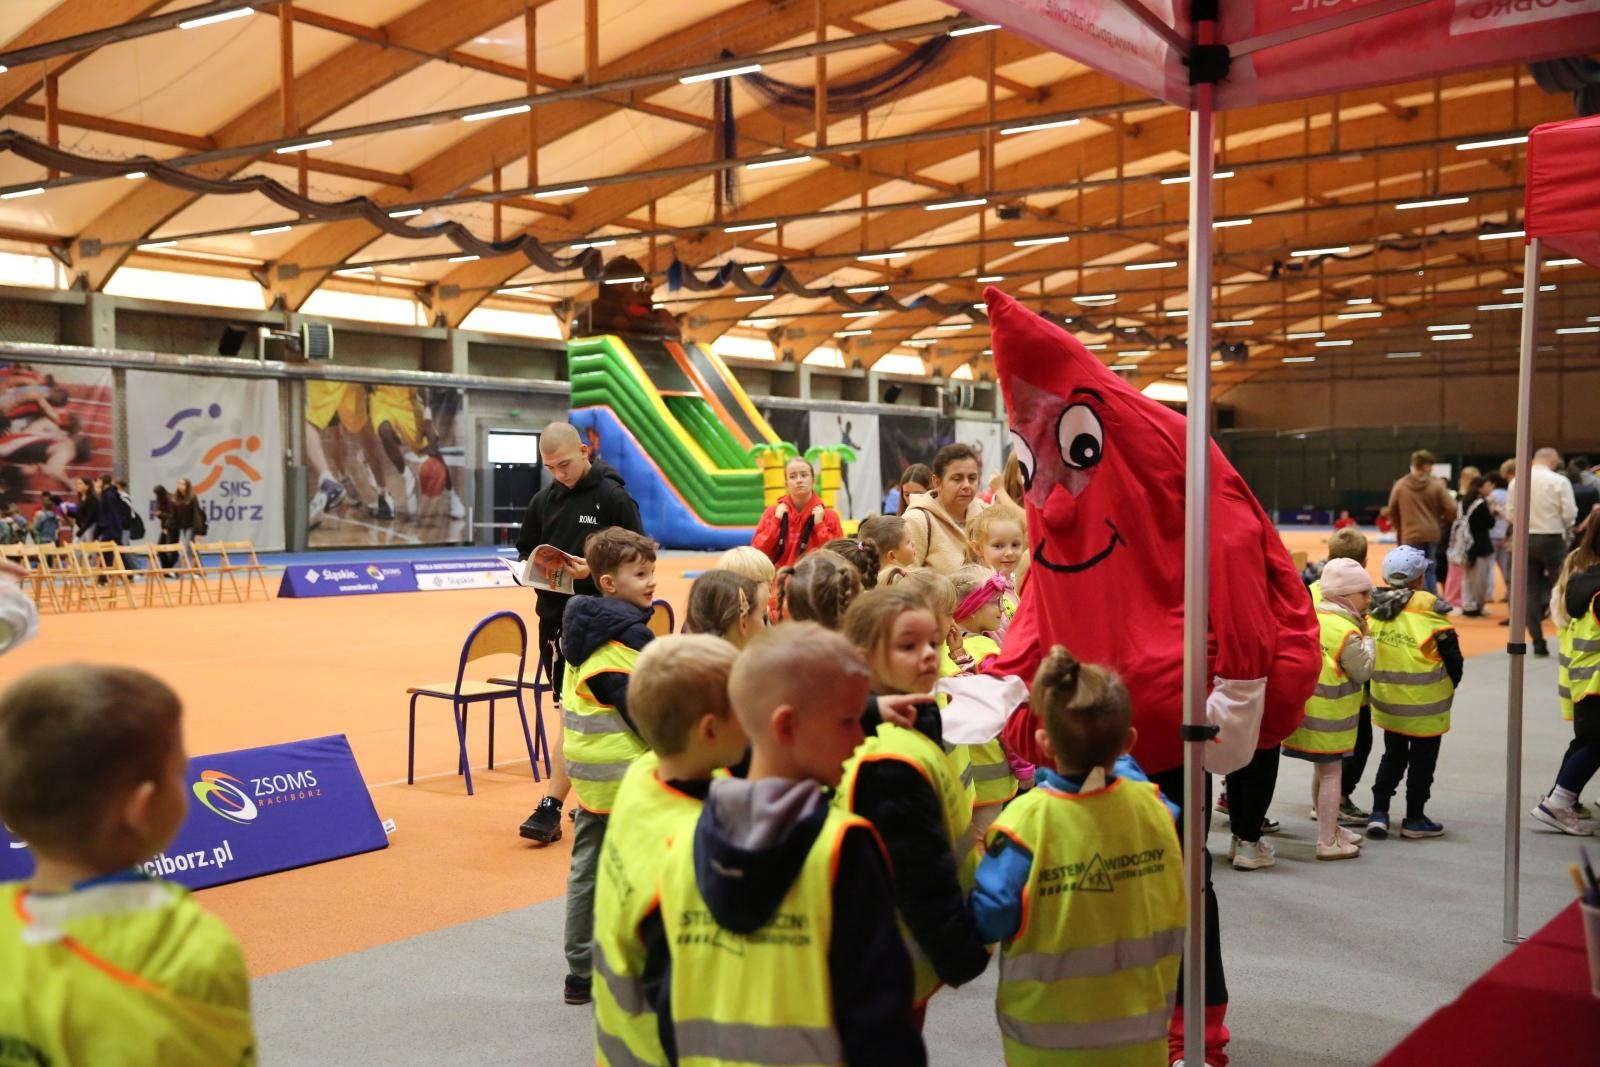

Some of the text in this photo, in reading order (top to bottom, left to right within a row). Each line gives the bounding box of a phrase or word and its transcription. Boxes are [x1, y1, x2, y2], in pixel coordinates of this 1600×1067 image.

[220, 480, 252, 498] SMS
[579, 515, 598, 524] ROMA
[250, 769, 317, 797] ZSOMS
[258, 788, 322, 807] RACIBÓRZ
